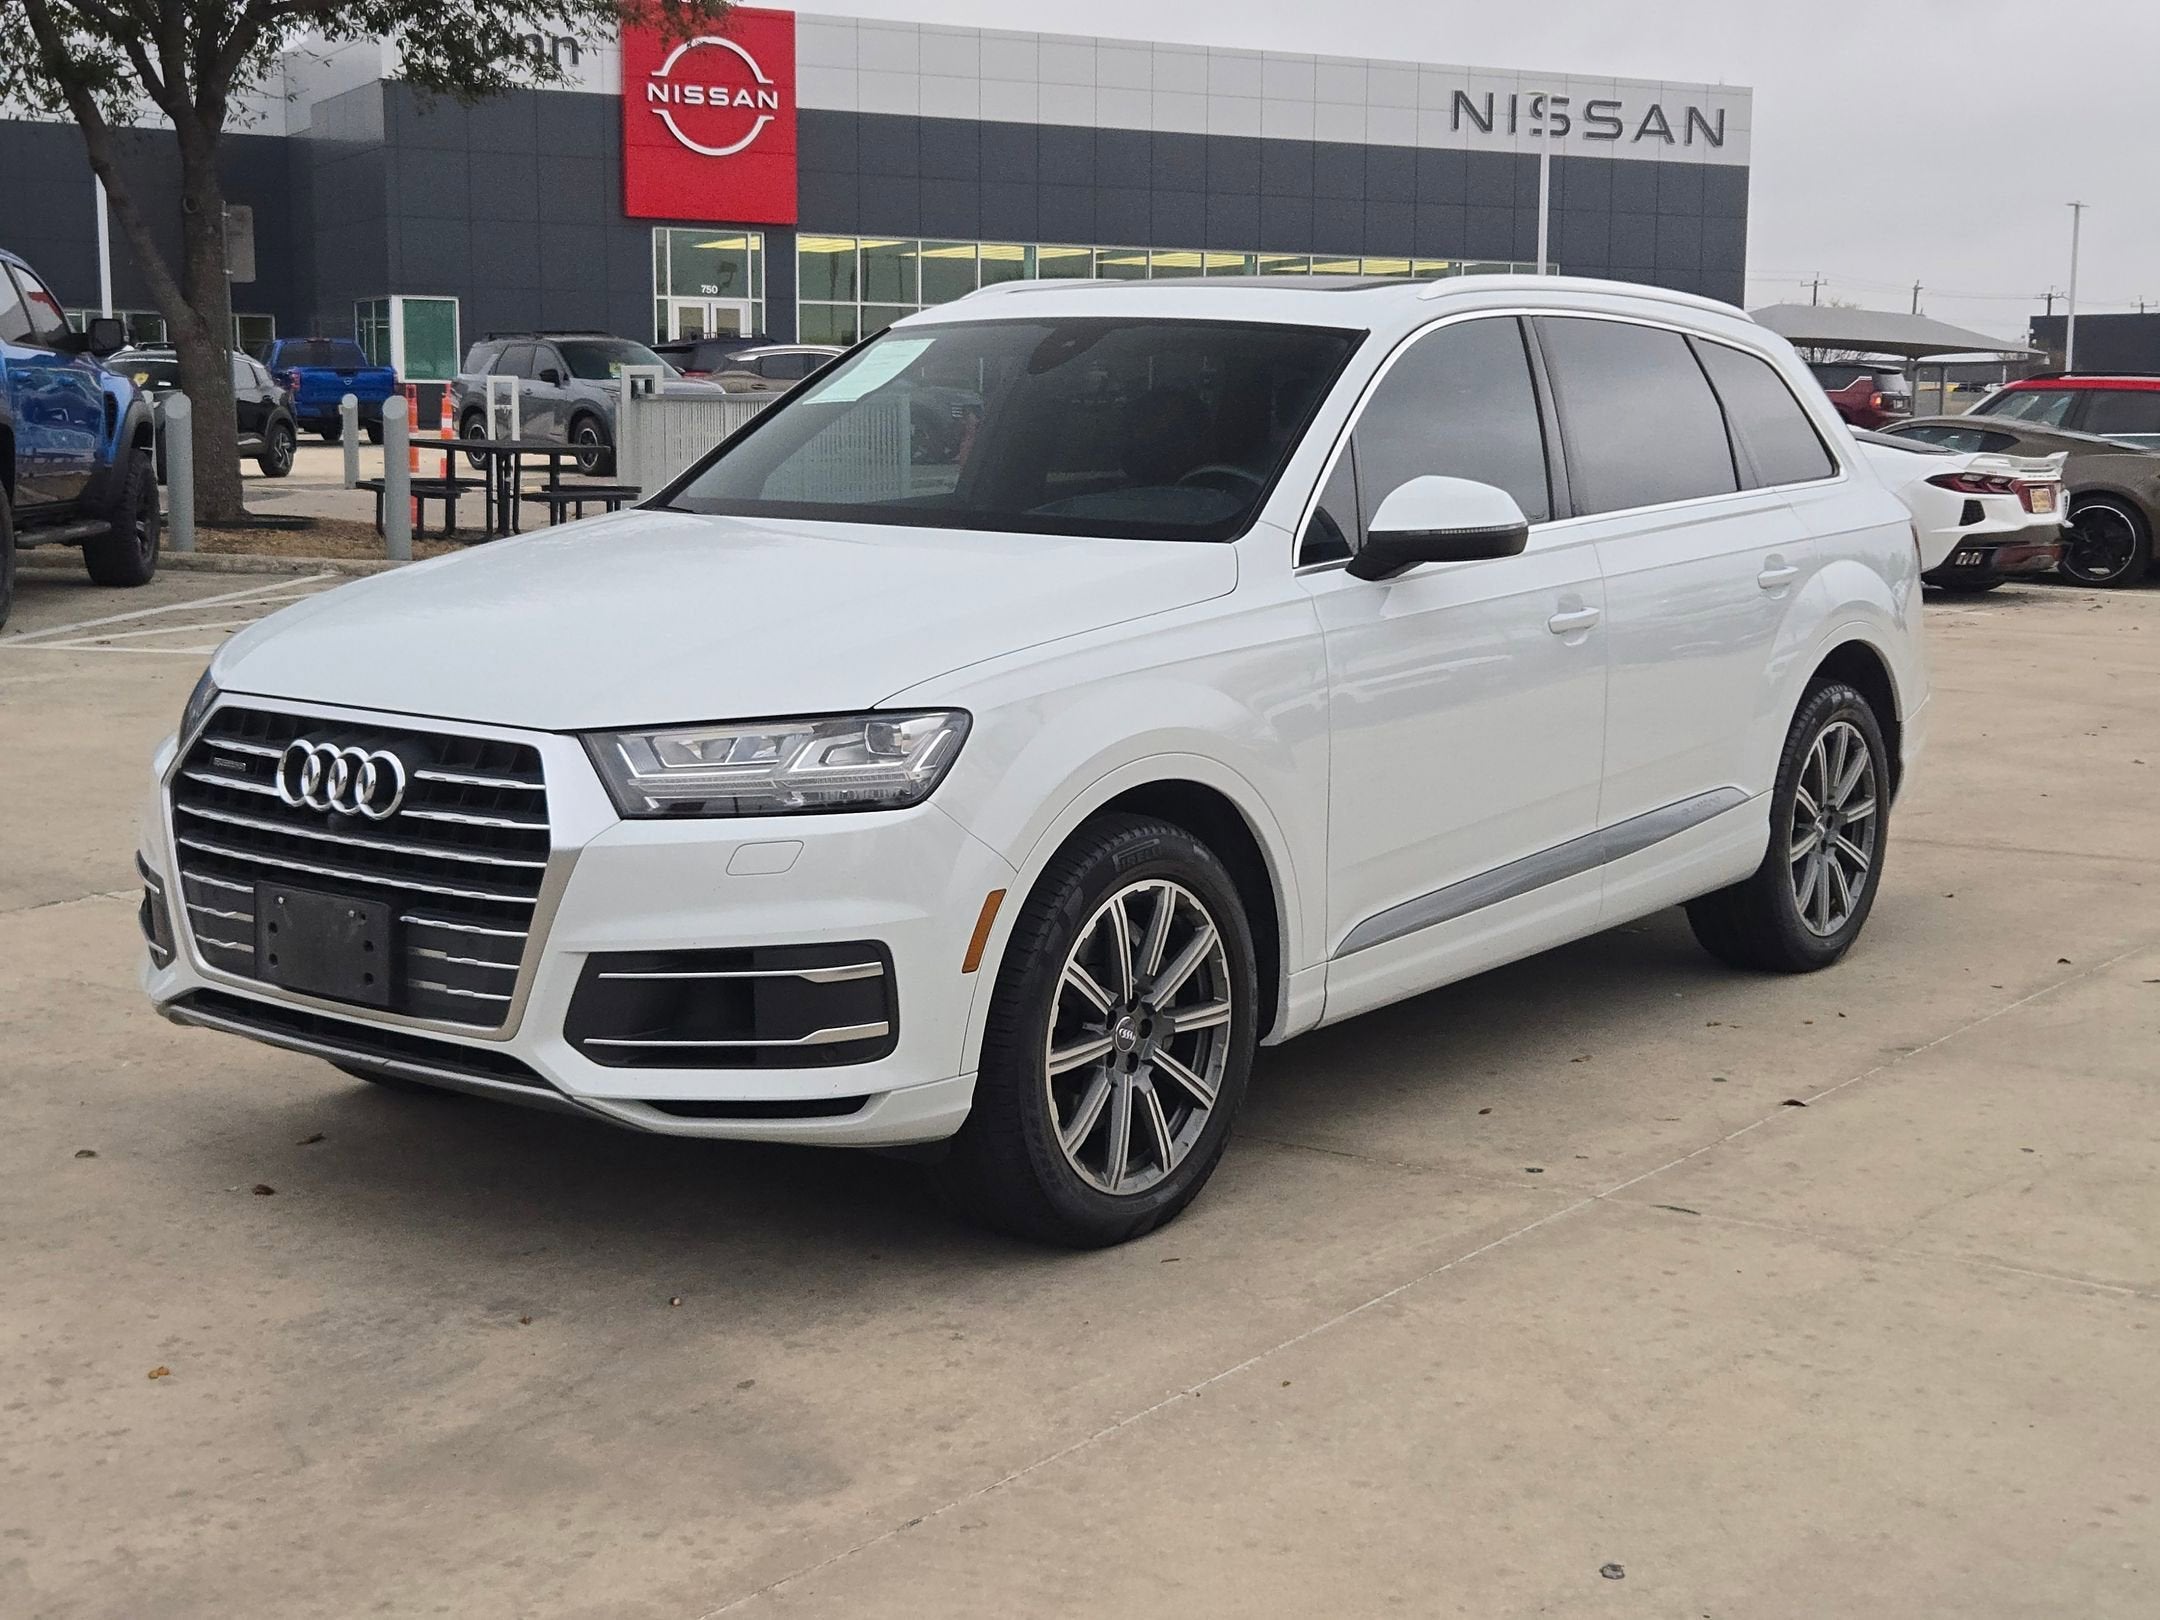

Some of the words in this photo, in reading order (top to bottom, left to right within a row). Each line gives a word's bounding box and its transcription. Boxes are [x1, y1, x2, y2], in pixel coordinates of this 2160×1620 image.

[647, 82, 779, 110] NISSAN
[1451, 89, 1726, 148] NISSAN
[700, 284, 719, 295] 750
